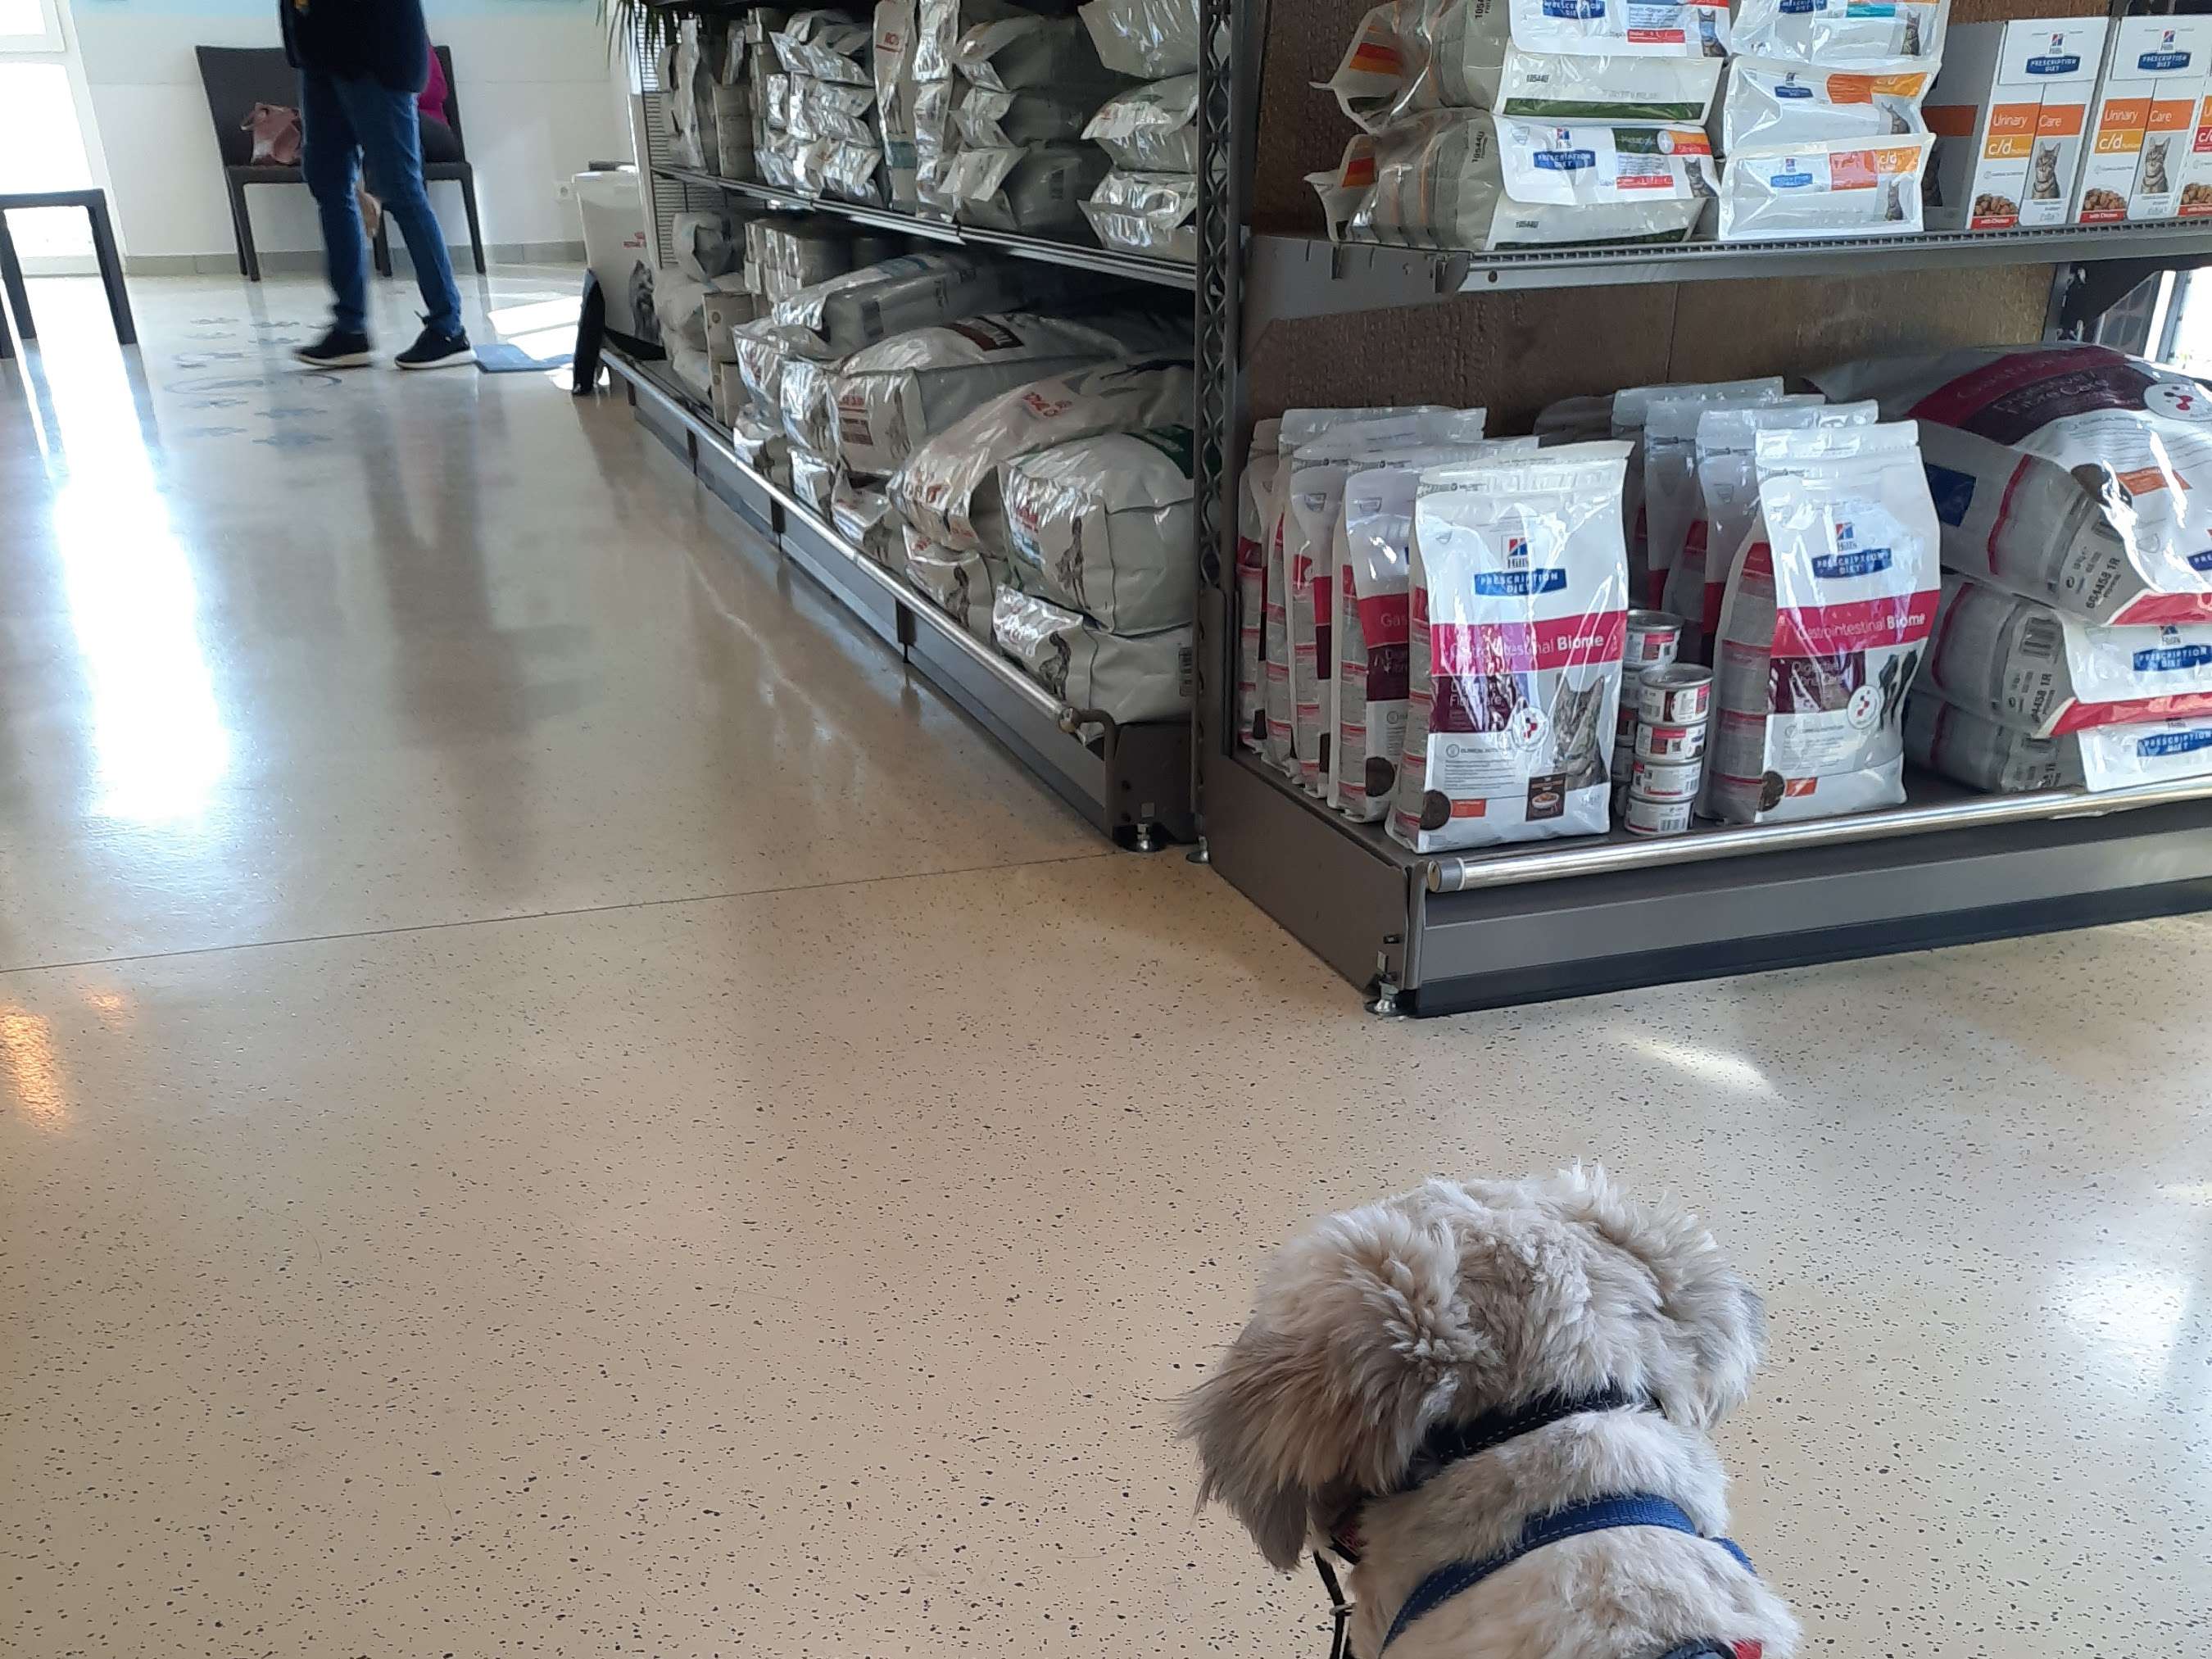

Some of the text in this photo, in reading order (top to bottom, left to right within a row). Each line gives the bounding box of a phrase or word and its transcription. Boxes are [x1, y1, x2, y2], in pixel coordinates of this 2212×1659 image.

[1993, 114, 2062, 129] Urinary Care
[2104, 109, 2173, 125] Urinary Care
[1988, 138, 2013, 156] c/d
[2098, 133, 2124, 151] c/d
[1480, 572, 1559, 586] PRESCRIPTION
[1887, 613, 1926, 630] Biome
[1557, 632, 1605, 652] Biome
[2138, 646, 2208, 661] PRESCRIPTION
